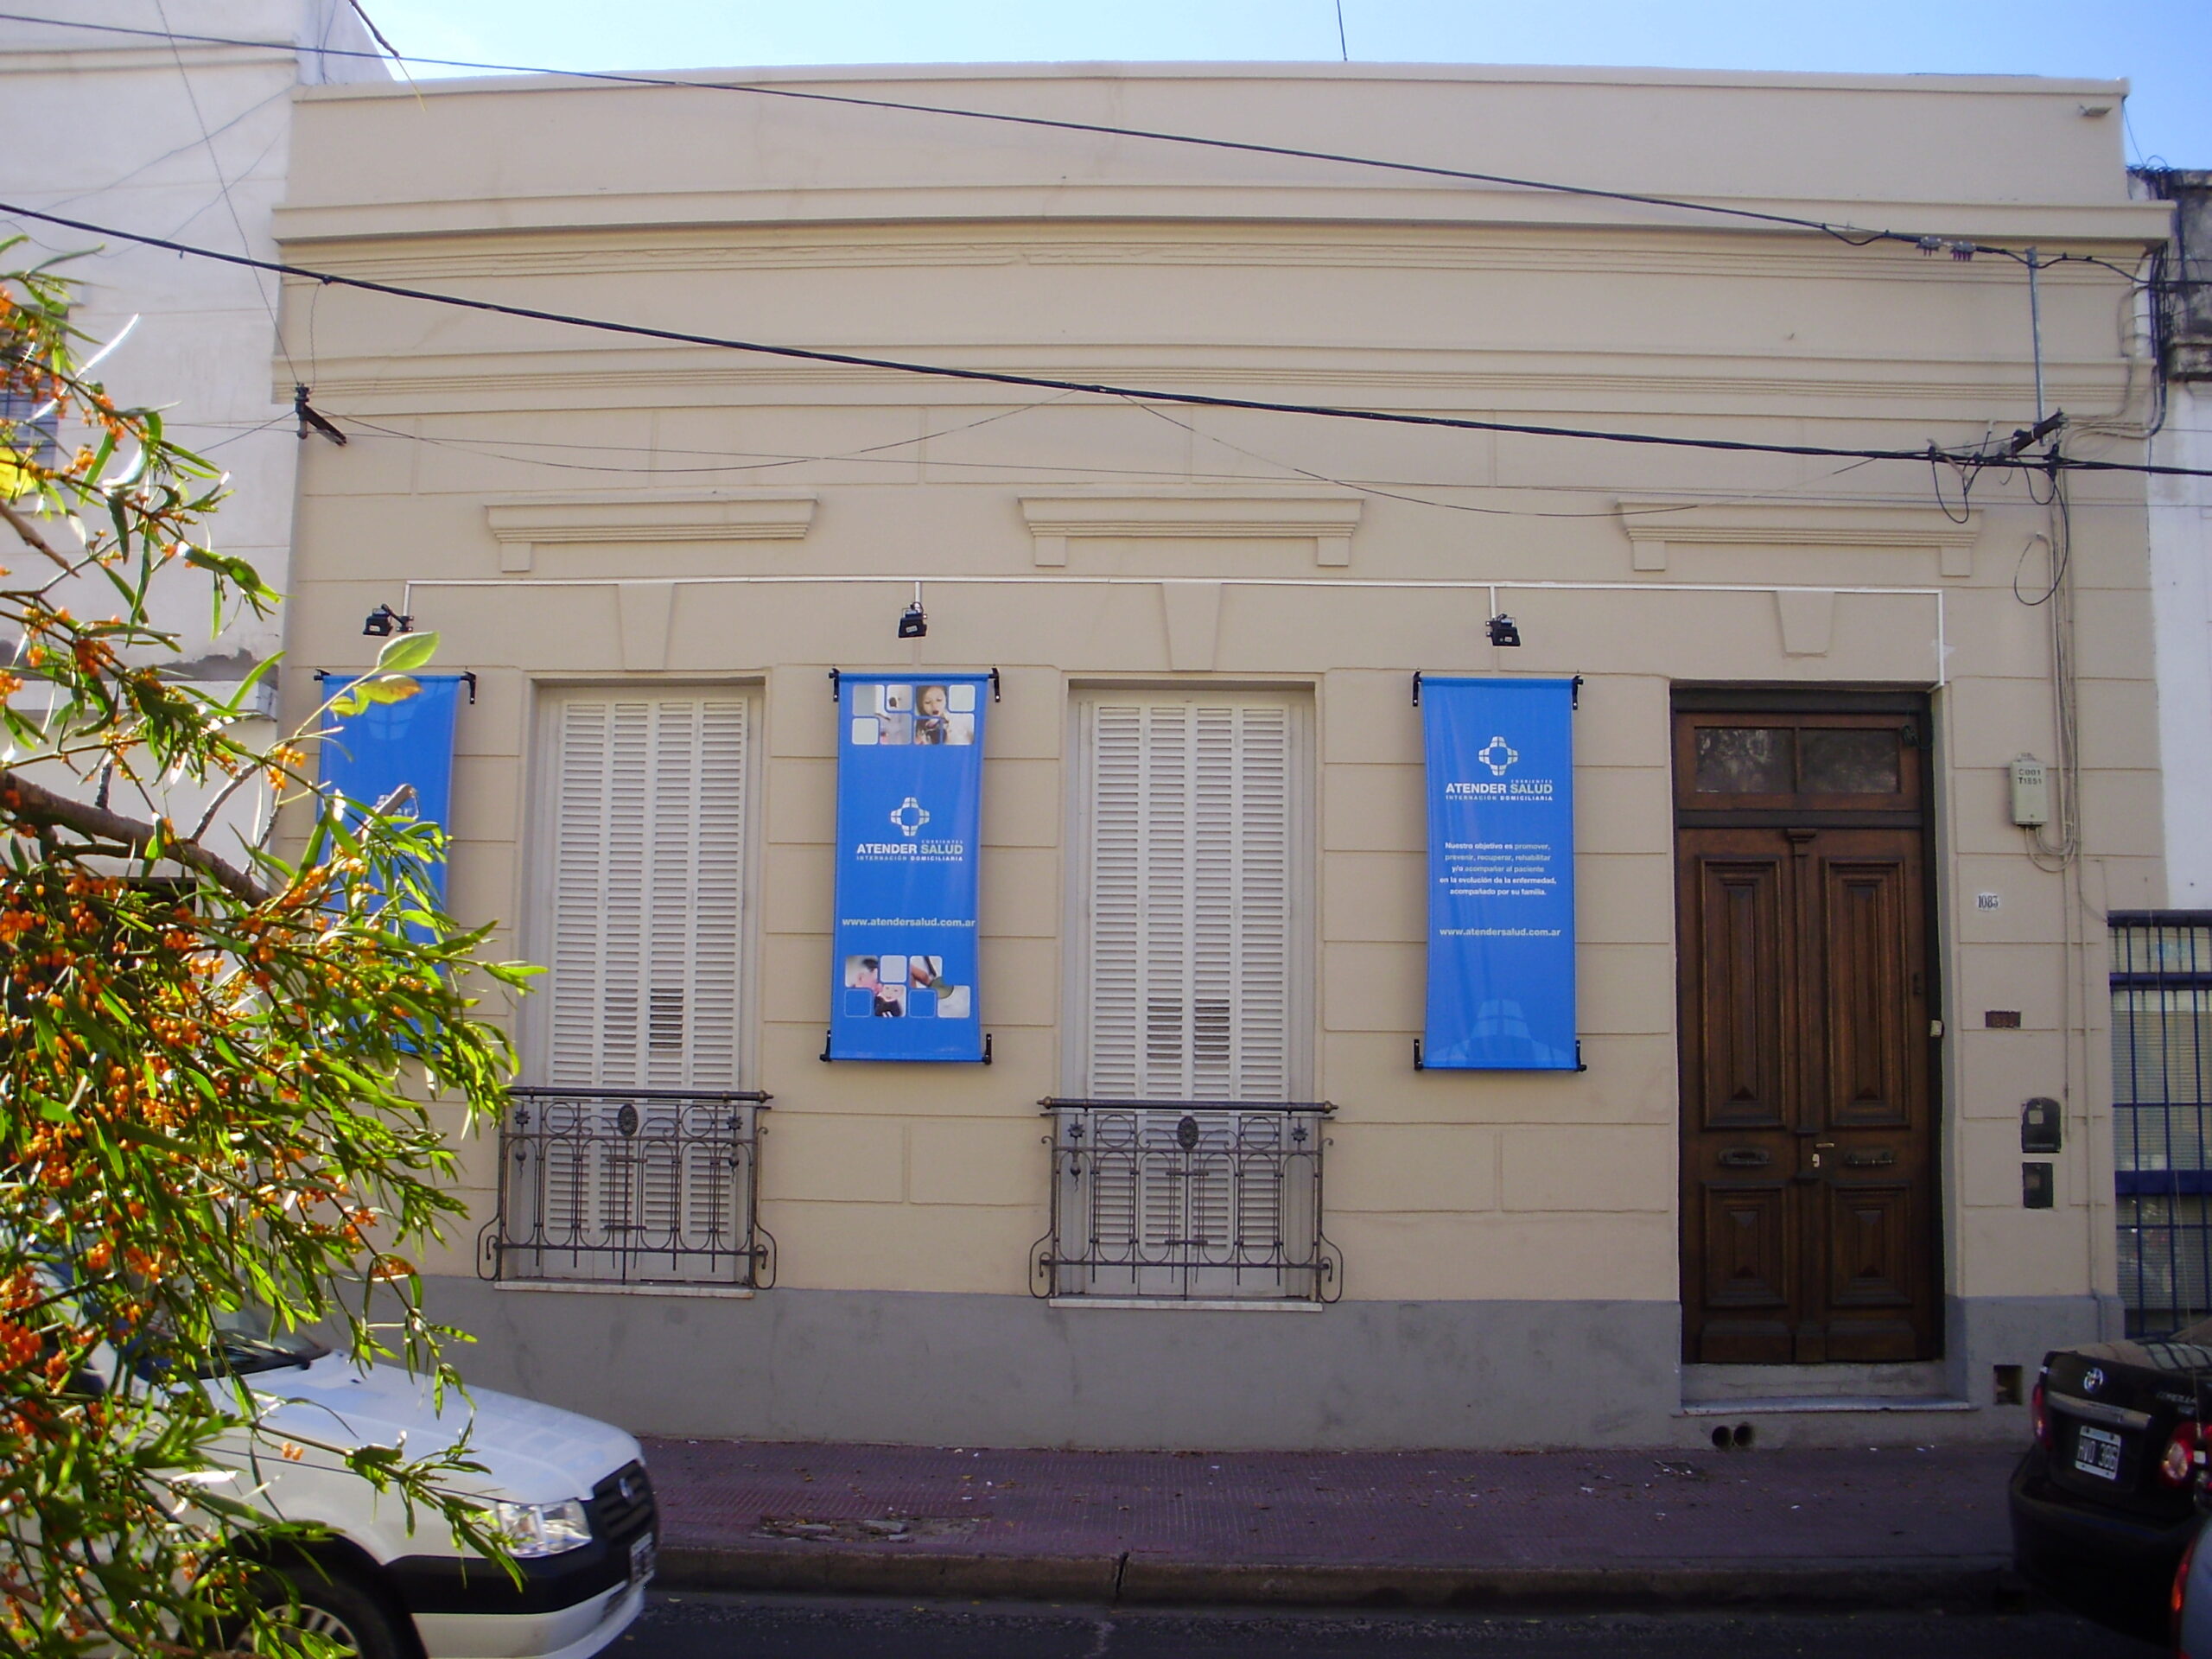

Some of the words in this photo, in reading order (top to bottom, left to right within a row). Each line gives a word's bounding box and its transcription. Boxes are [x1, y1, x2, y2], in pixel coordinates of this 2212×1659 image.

[1446, 783, 1507, 794] ATENDER
[1510, 784, 1553, 794] SALUD
[856, 843, 918, 855] ATENDER
[920, 844, 963, 855] SALUD
[1474, 842, 1503, 850] objetivo
[1449, 887, 1497, 896] acompañado
[842, 917, 976, 928] www.atendersalud.com.ar
[1439, 927, 1561, 937] www.atendersalud.com.ar
